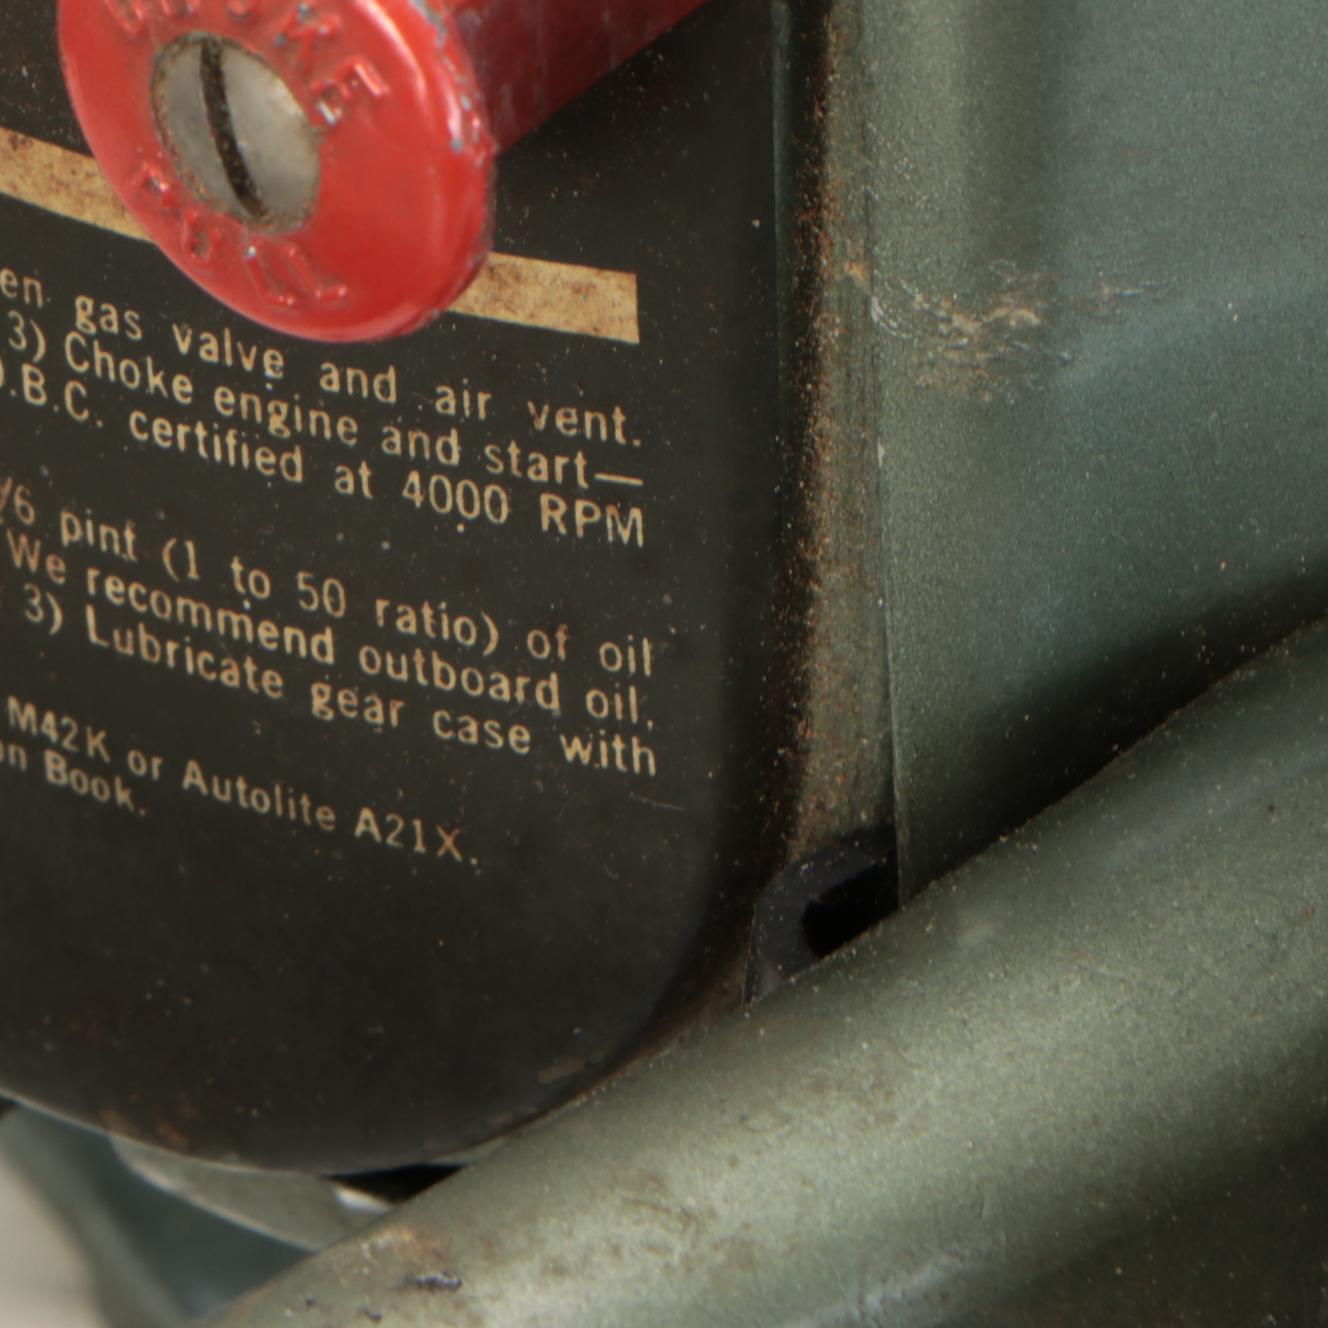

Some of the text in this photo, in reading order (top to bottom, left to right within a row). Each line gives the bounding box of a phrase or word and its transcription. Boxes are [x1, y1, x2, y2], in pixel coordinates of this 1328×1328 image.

[8, 309, 46, 363] 3)
[64, 330, 193, 404] Choke
[213, 381, 359, 446] engine
[381, 425, 460, 466] and
[74, 294, 143, 341] gas
[173, 324, 285, 379] valve
[319, 360, 397, 404] and
[434, 378, 491, 422] air
[528, 397, 642, 448] vent.
[129, 406, 304, 483] certified
[334, 459, 374, 499] at
[401, 469, 509, 525] 4000
[539, 493, 644, 547] RPM
[6, 527, 67, 585] We
[86, 564, 335, 665] recommend
[358, 642, 561, 714] outboard
[59, 507, 137, 563] pint
[161, 537, 198, 582] (1
[230, 555, 271, 600] to
[297, 572, 347, 616] 50
[374, 597, 499, 656] ratio)
[527, 622, 569, 661] of
[599, 635, 652, 677] oil
[22, 583, 63, 636] 3)
[84, 604, 285, 700] Lubricate
[310, 680, 405, 726] gear
[432, 707, 532, 755] case
[559, 729, 657, 777] with
[6, 694, 112, 764] M42K
[127, 748, 164, 781] or
[181, 759, 337, 833] Autolite
[354, 806, 480, 866] A21X.
[43, 748, 149, 817] Book.
